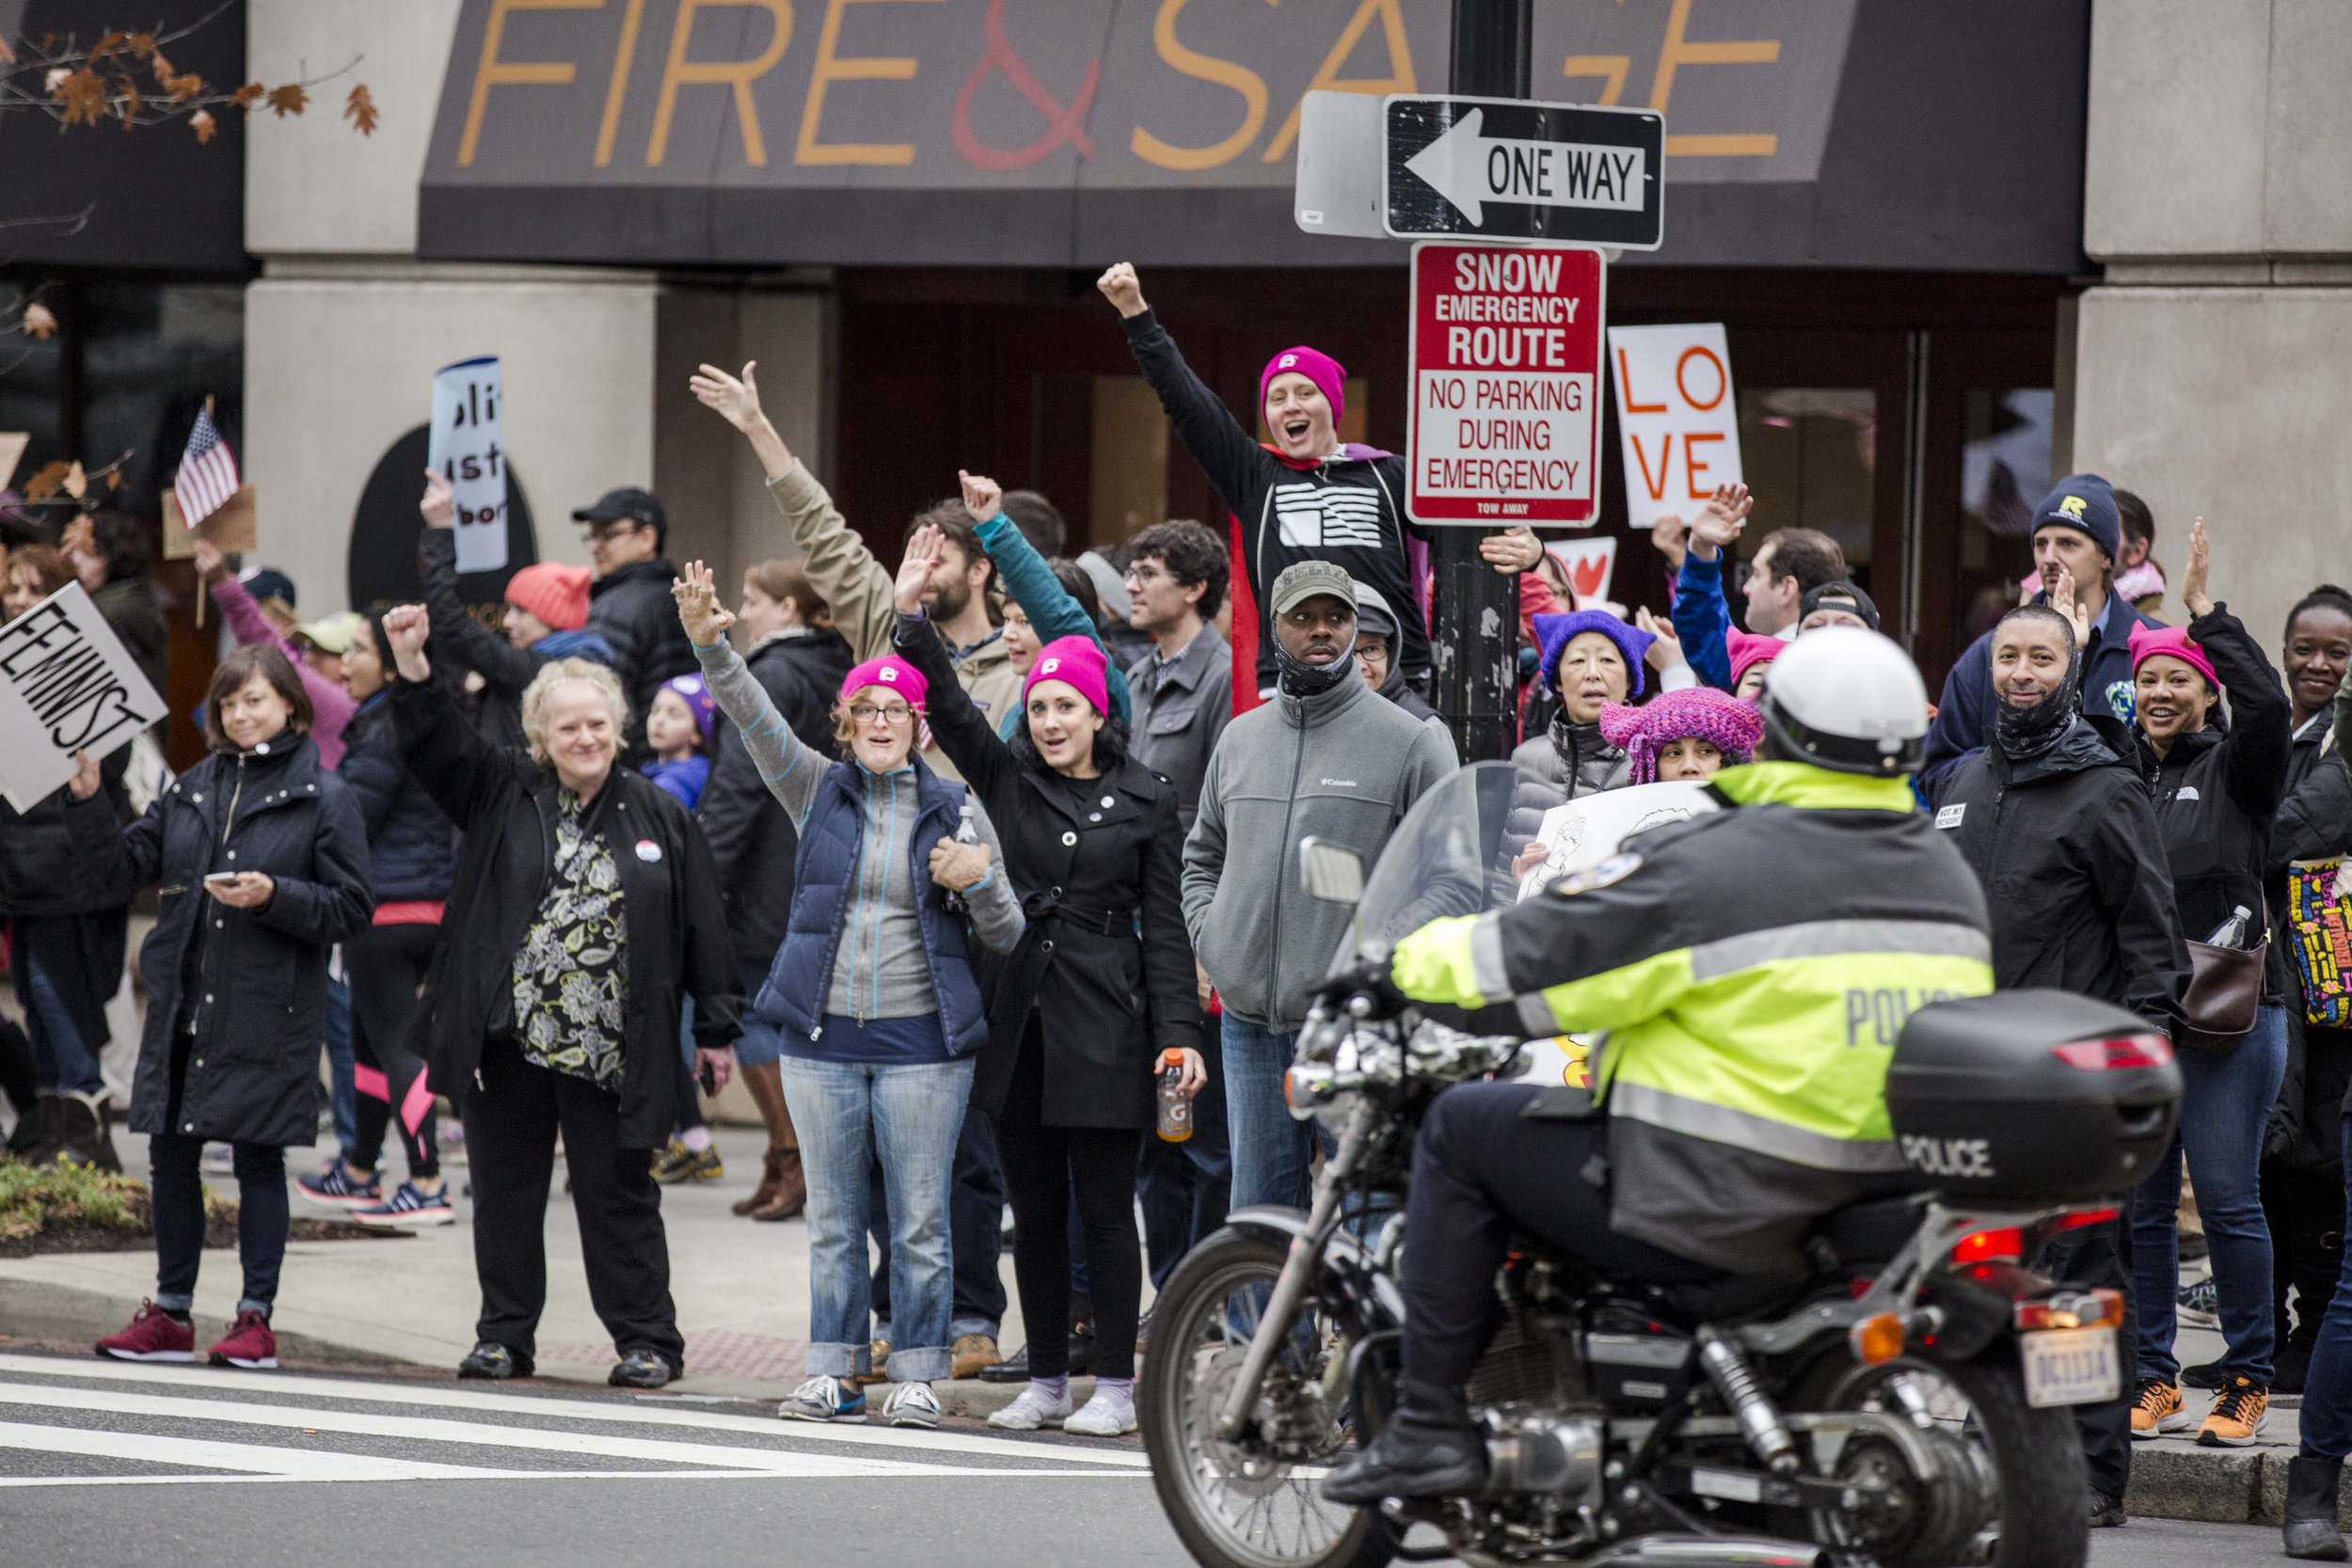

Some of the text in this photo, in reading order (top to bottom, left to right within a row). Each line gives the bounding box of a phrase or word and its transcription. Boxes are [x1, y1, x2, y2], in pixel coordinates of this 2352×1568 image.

[456, 0, 946, 167] FIRE
[950, 0, 1102, 171] &
[1487, 144, 1635, 202] ONE WAY
[1454, 251, 1563, 293] SNOW
[1436, 293, 1580, 324] EMERGENCY
[1448, 325, 1565, 367] ROUTE
[1429, 378, 1581, 411] NO PARKING
[1459, 419, 1550, 451] DURING
[1427, 458, 1579, 491] EMERGENCY
[1477, 502, 1529, 515] TOW AWAY
[0, 601, 149, 759] FEMINIST
[1327, 778, 1357, 786] Columbia
[1936, 816, 1962, 827] PRESIDENT
[1900, 1134, 1995, 1177] POLICE
